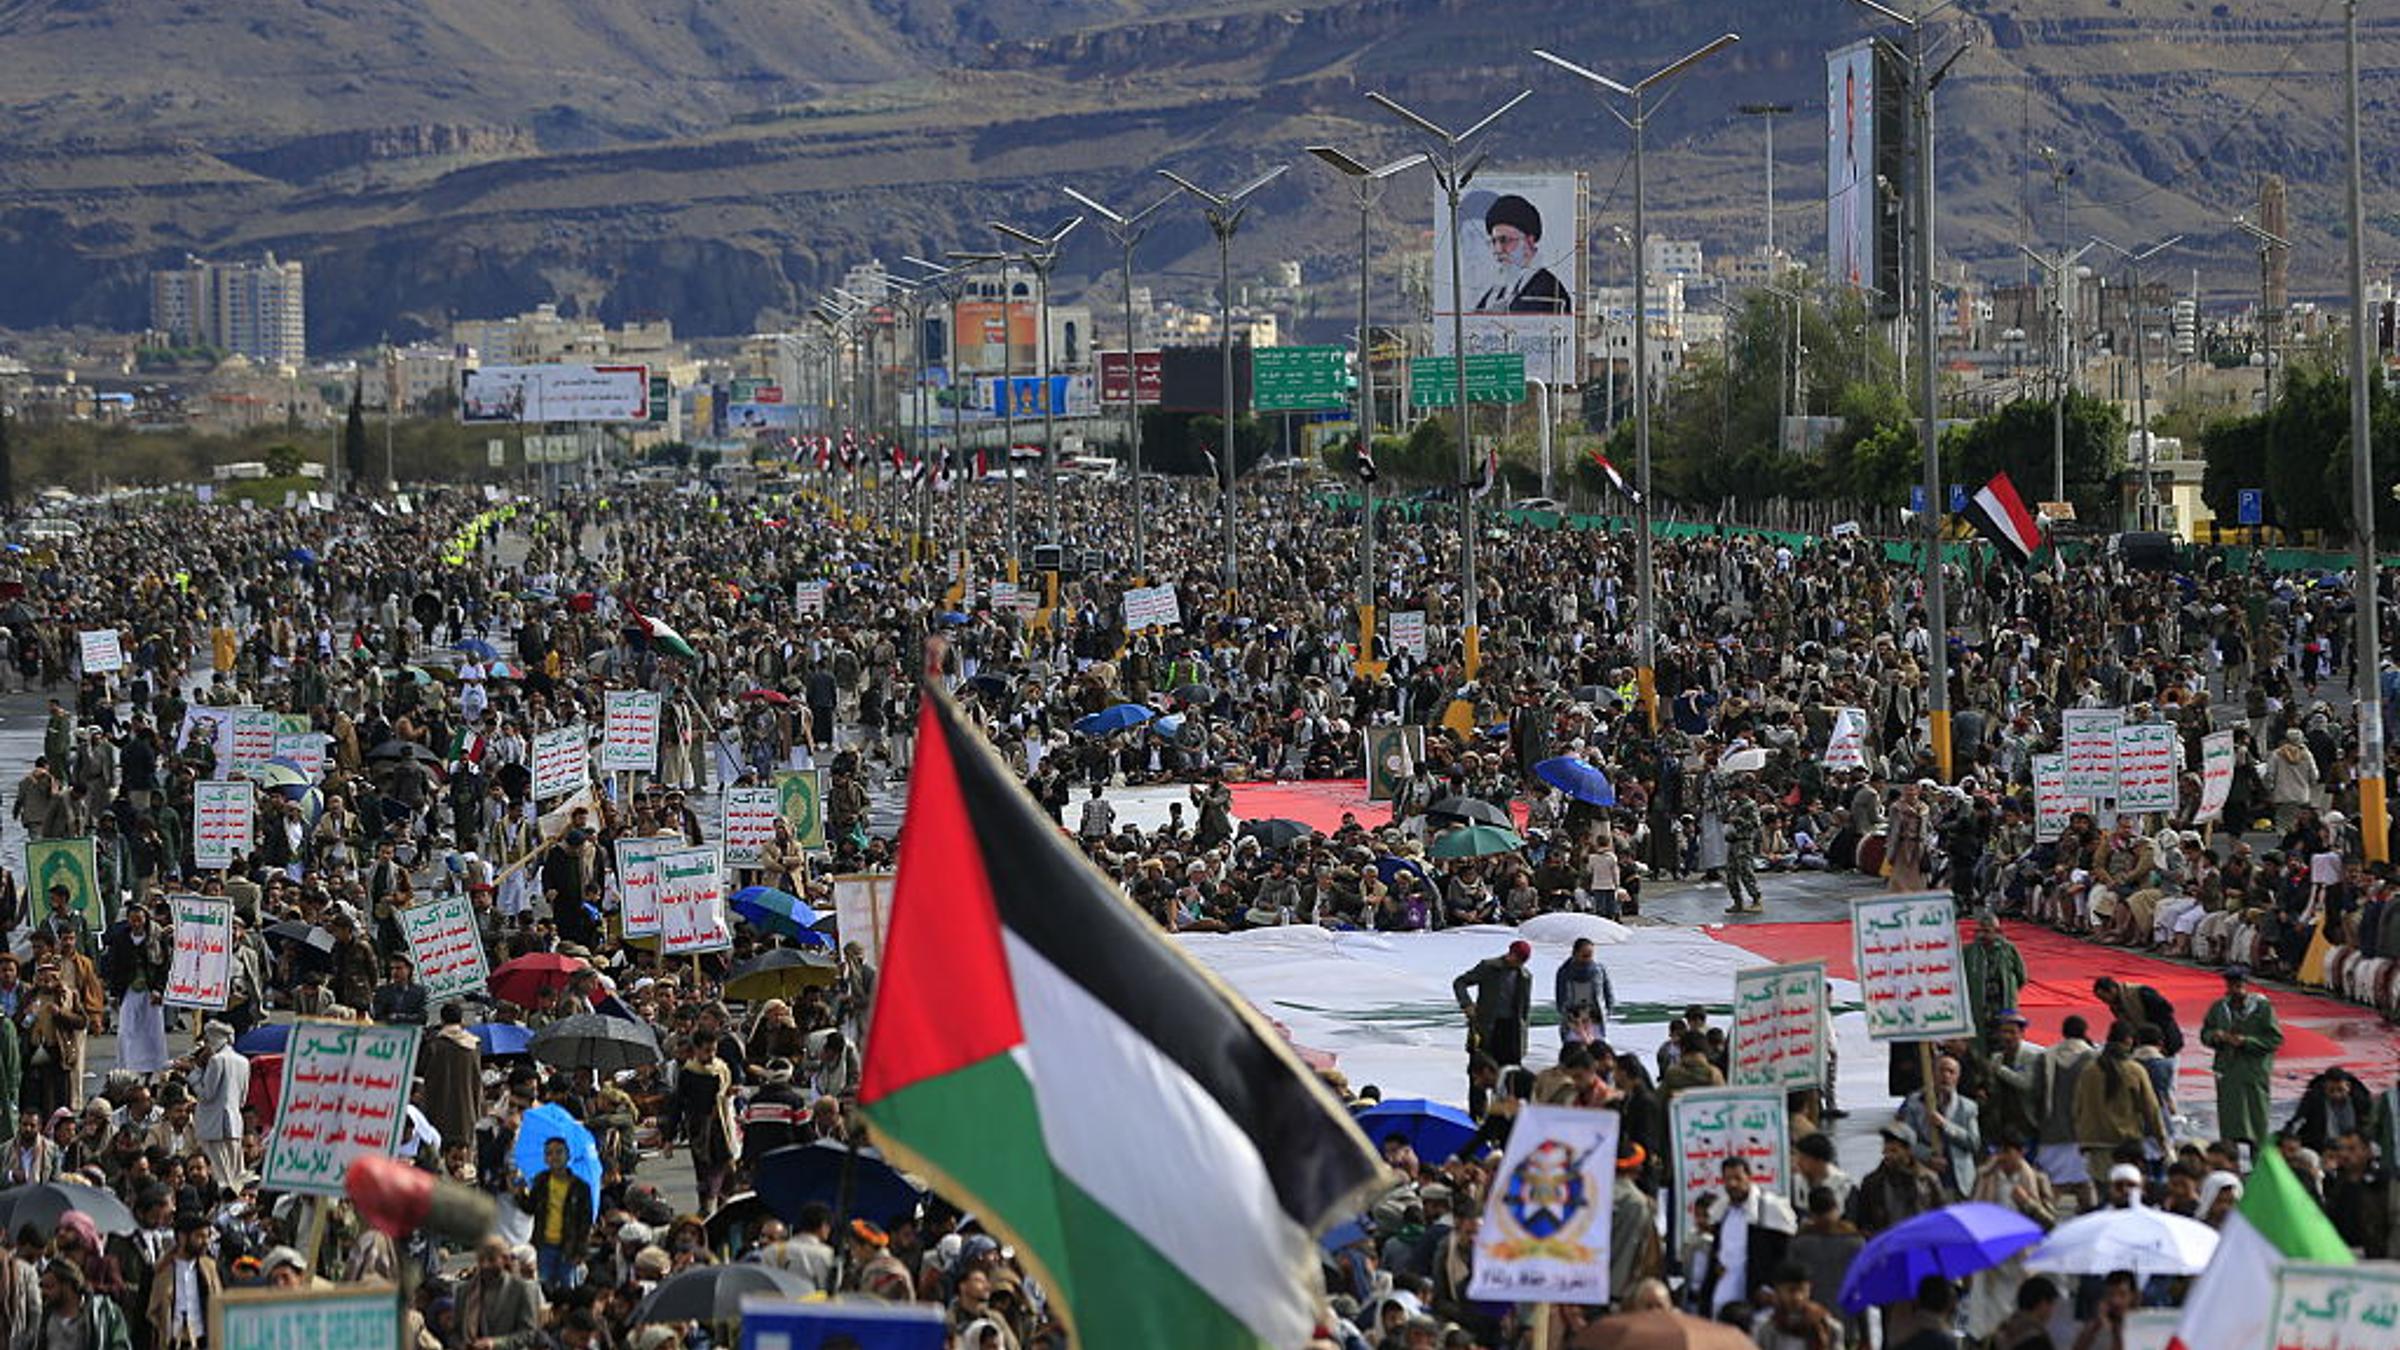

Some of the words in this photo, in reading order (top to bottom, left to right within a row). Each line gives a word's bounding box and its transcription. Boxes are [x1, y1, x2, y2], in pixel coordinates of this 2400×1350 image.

[2243, 493, 2252, 504] P
[1864, 906, 1912, 936] أكبر
[1919, 906, 1951, 926] الله
[1914, 940, 1951, 954] الموت
[1916, 960, 1954, 975] الموت
[1868, 986, 1901, 1002] اليهود
[1905, 987, 1922, 1001] على
[1928, 981, 1957, 996] اللعنة
[1871, 1005, 1915, 1028] للإسلام
[1920, 1003, 1959, 1028] النصر
[300, 1028, 358, 1061] أكبر
[365, 1035, 408, 1060] الله
[353, 1071, 399, 1091] الموت
[347, 1100, 394, 1121] الموت
[281, 1122, 322, 1143] اليهود
[324, 1126, 347, 1145] على
[354, 1128, 390, 1147] اللعنة
[275, 1147, 332, 1181] للإسلام
[2285, 1285, 2360, 1331] أكبر
[2361, 1292, 2399, 1329] لله
